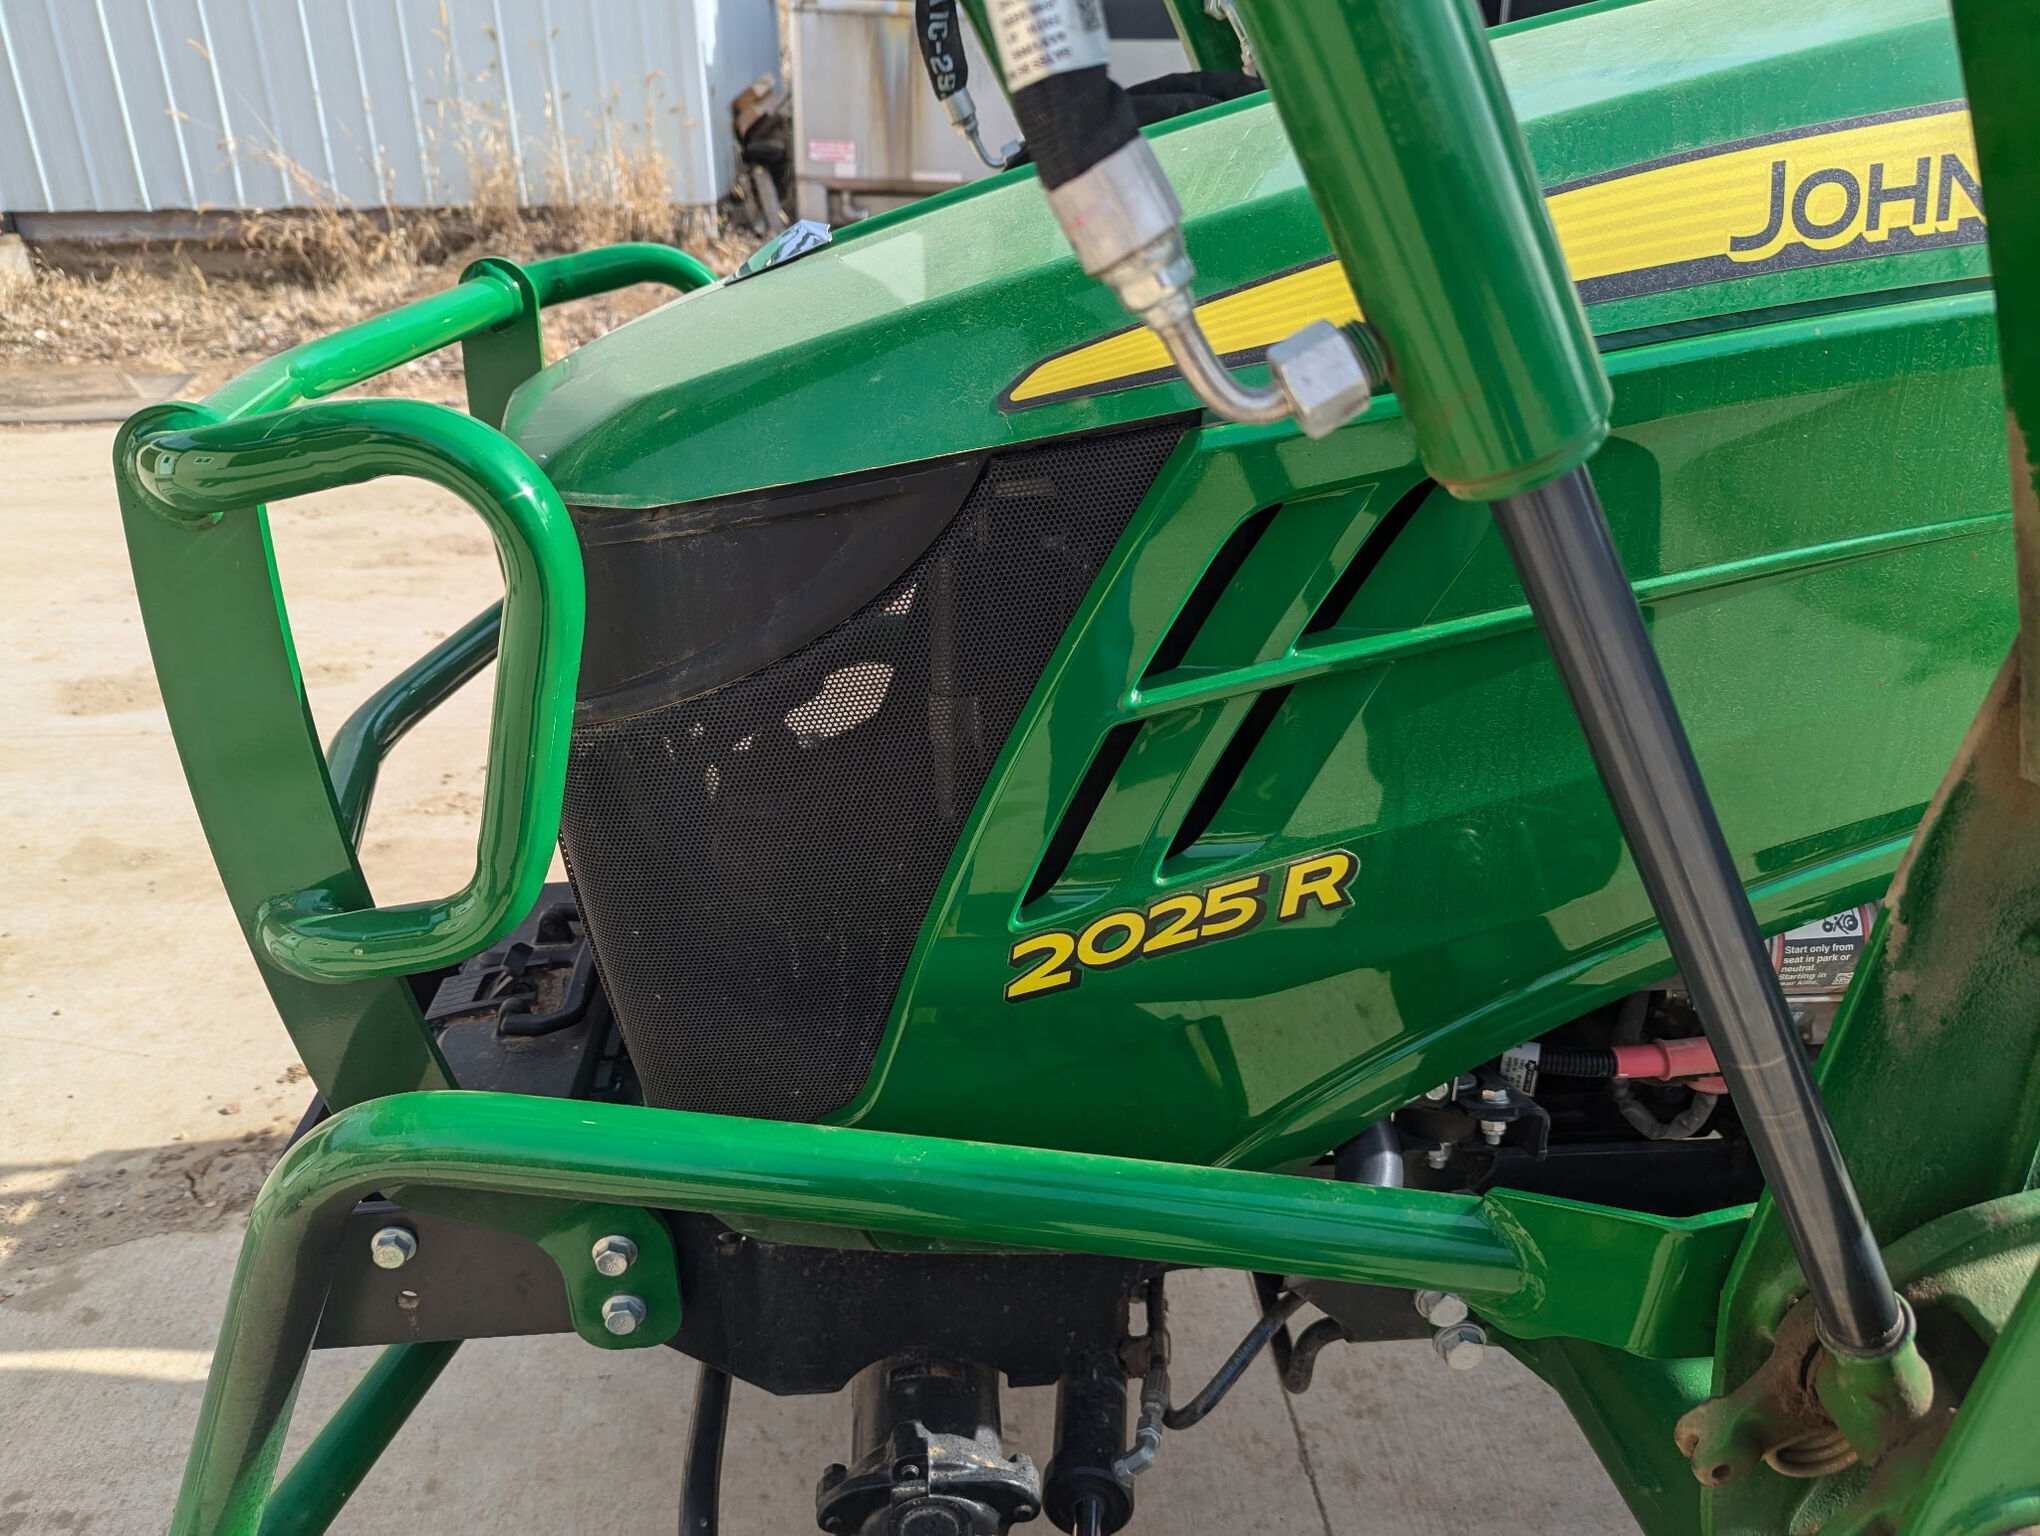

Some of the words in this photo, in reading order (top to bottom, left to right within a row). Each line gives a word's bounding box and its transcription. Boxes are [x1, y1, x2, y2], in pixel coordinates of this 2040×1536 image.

[927, 10, 956, 99] IC-29
[1729, 153, 1987, 254] JOHN
[1005, 874, 1267, 1001] 2025
[1278, 851, 1357, 921] R
[1784, 945, 1807, 954] Start
[1809, 944, 1830, 954] only
[1832, 943, 1854, 951] from
[1783, 956, 1803, 964] seat
[1805, 955, 1815, 963] in
[1816, 954, 1838, 964] park
[1781, 964, 1816, 973] neutral.
[1778, 972, 1815, 980] Starting
